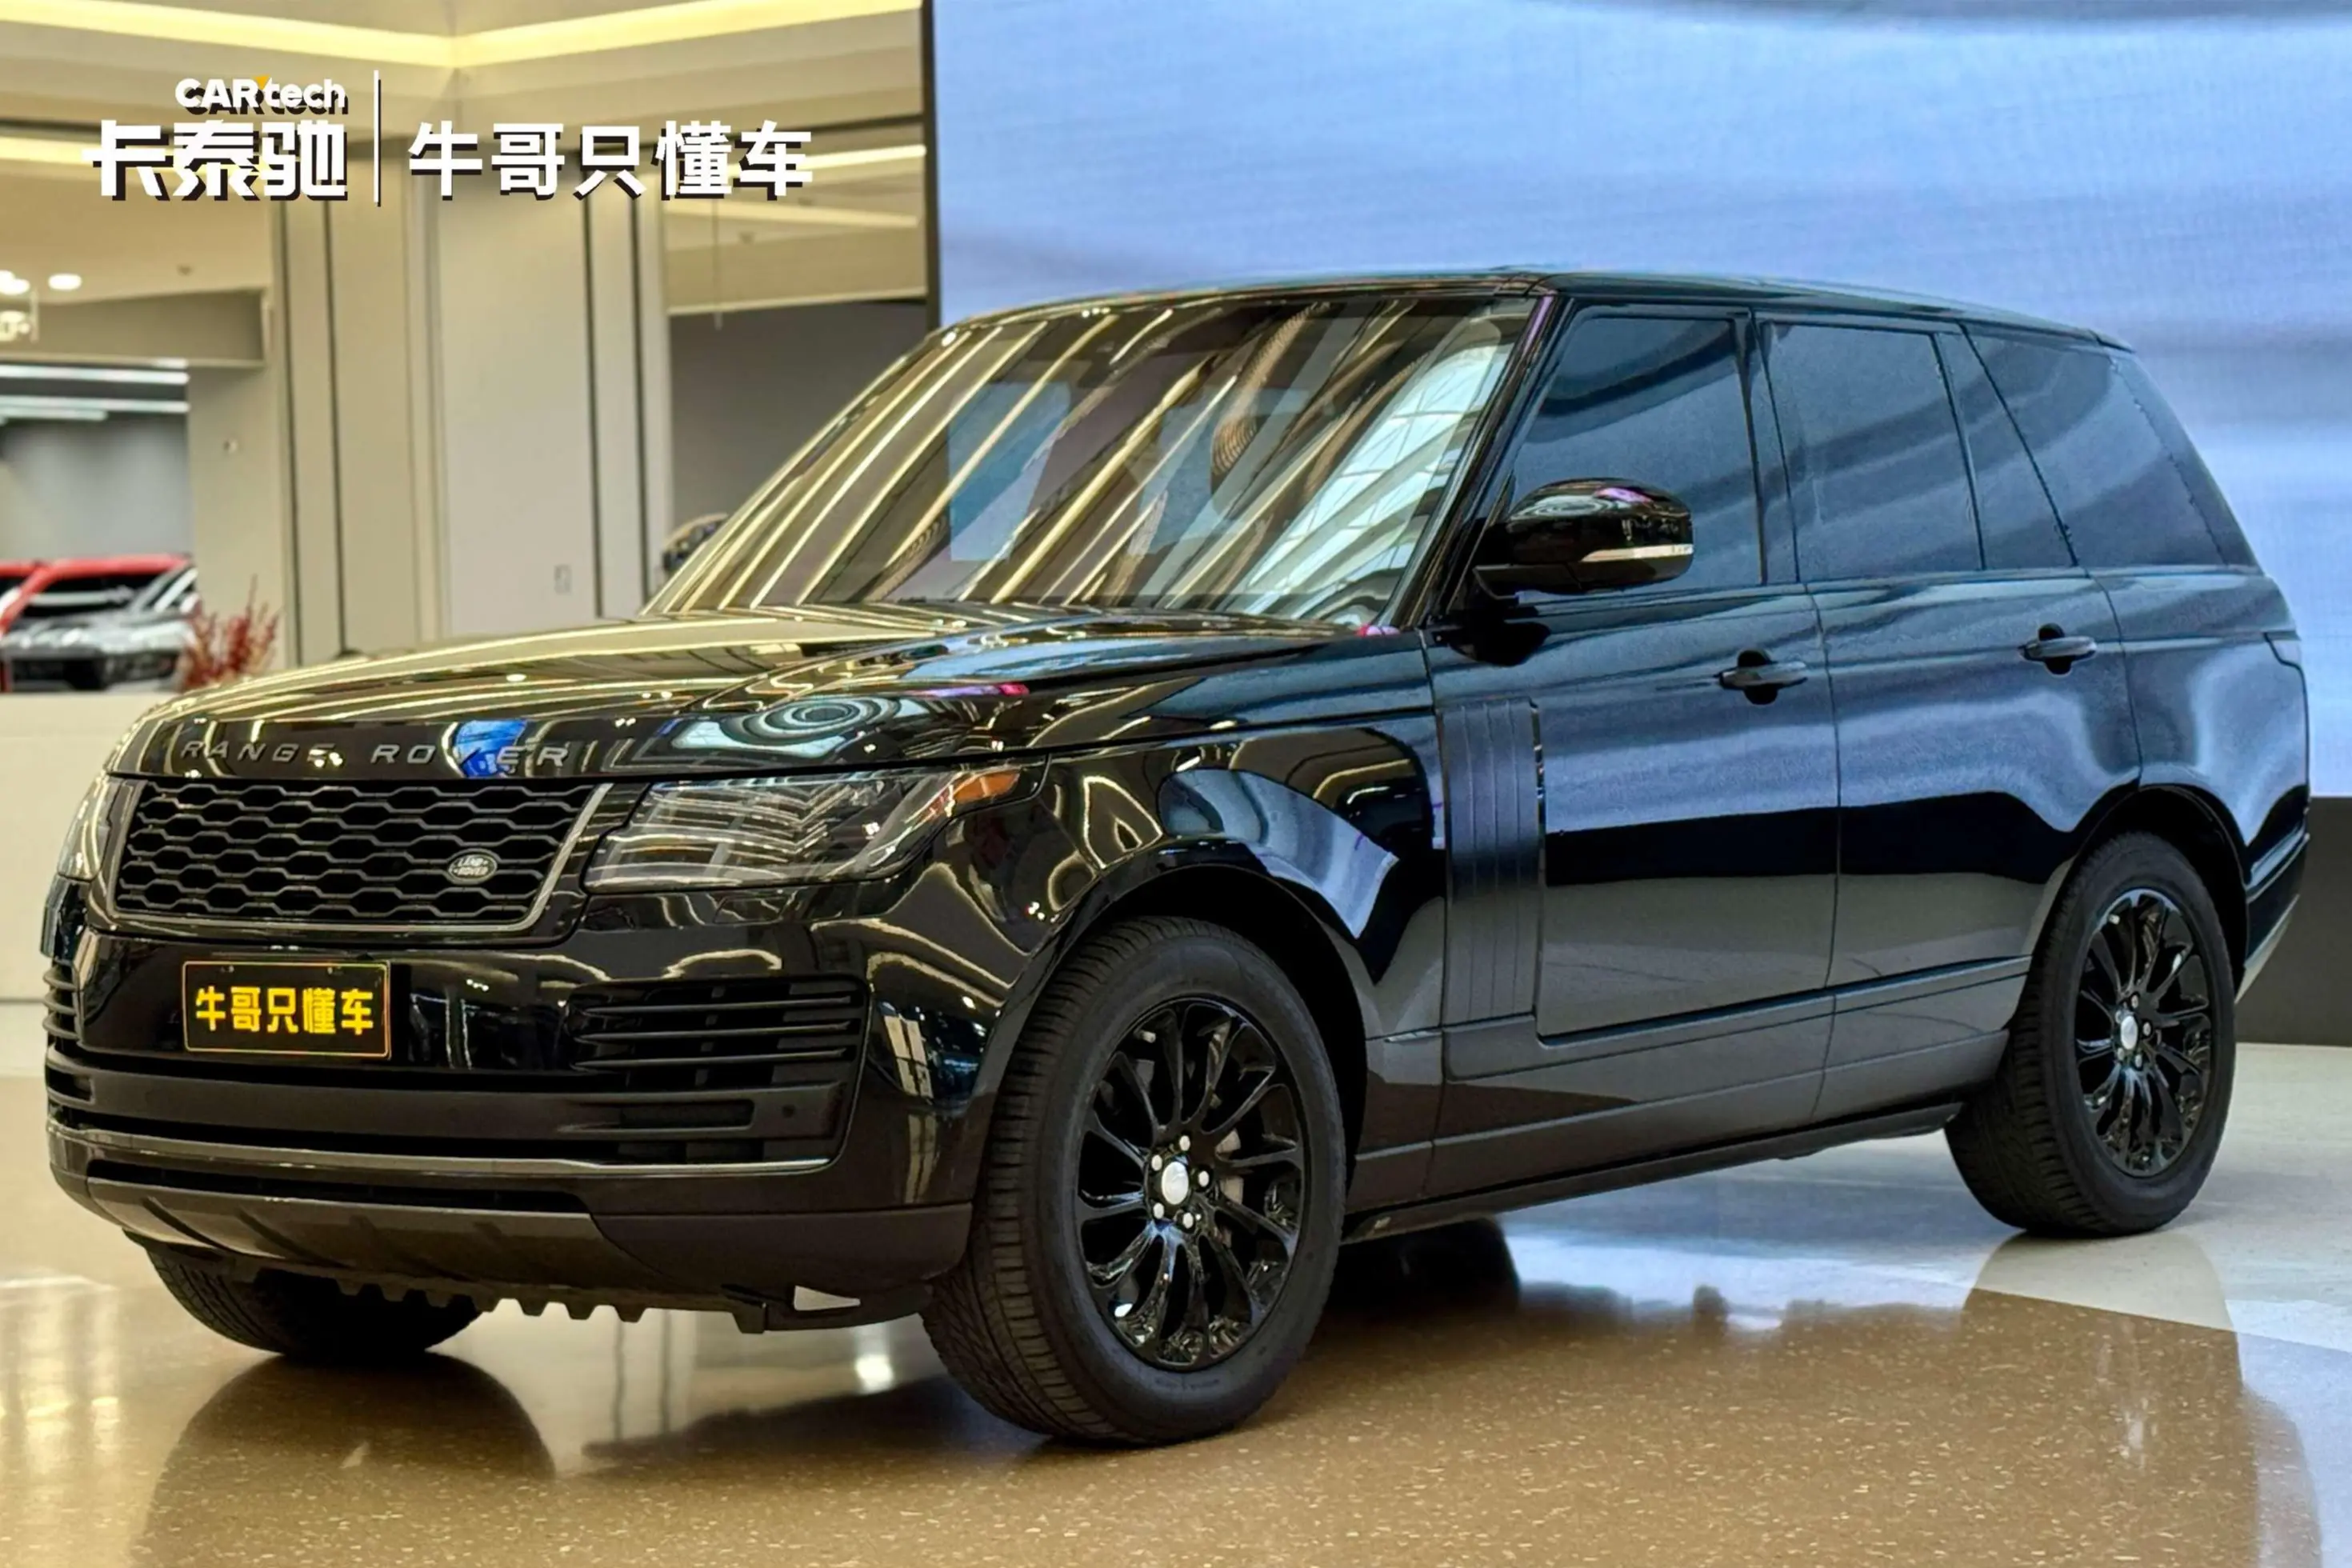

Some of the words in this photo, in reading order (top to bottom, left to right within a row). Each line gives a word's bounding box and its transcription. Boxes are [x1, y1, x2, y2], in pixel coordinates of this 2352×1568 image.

[195, 986, 374, 1035] 牛哥只懂车
